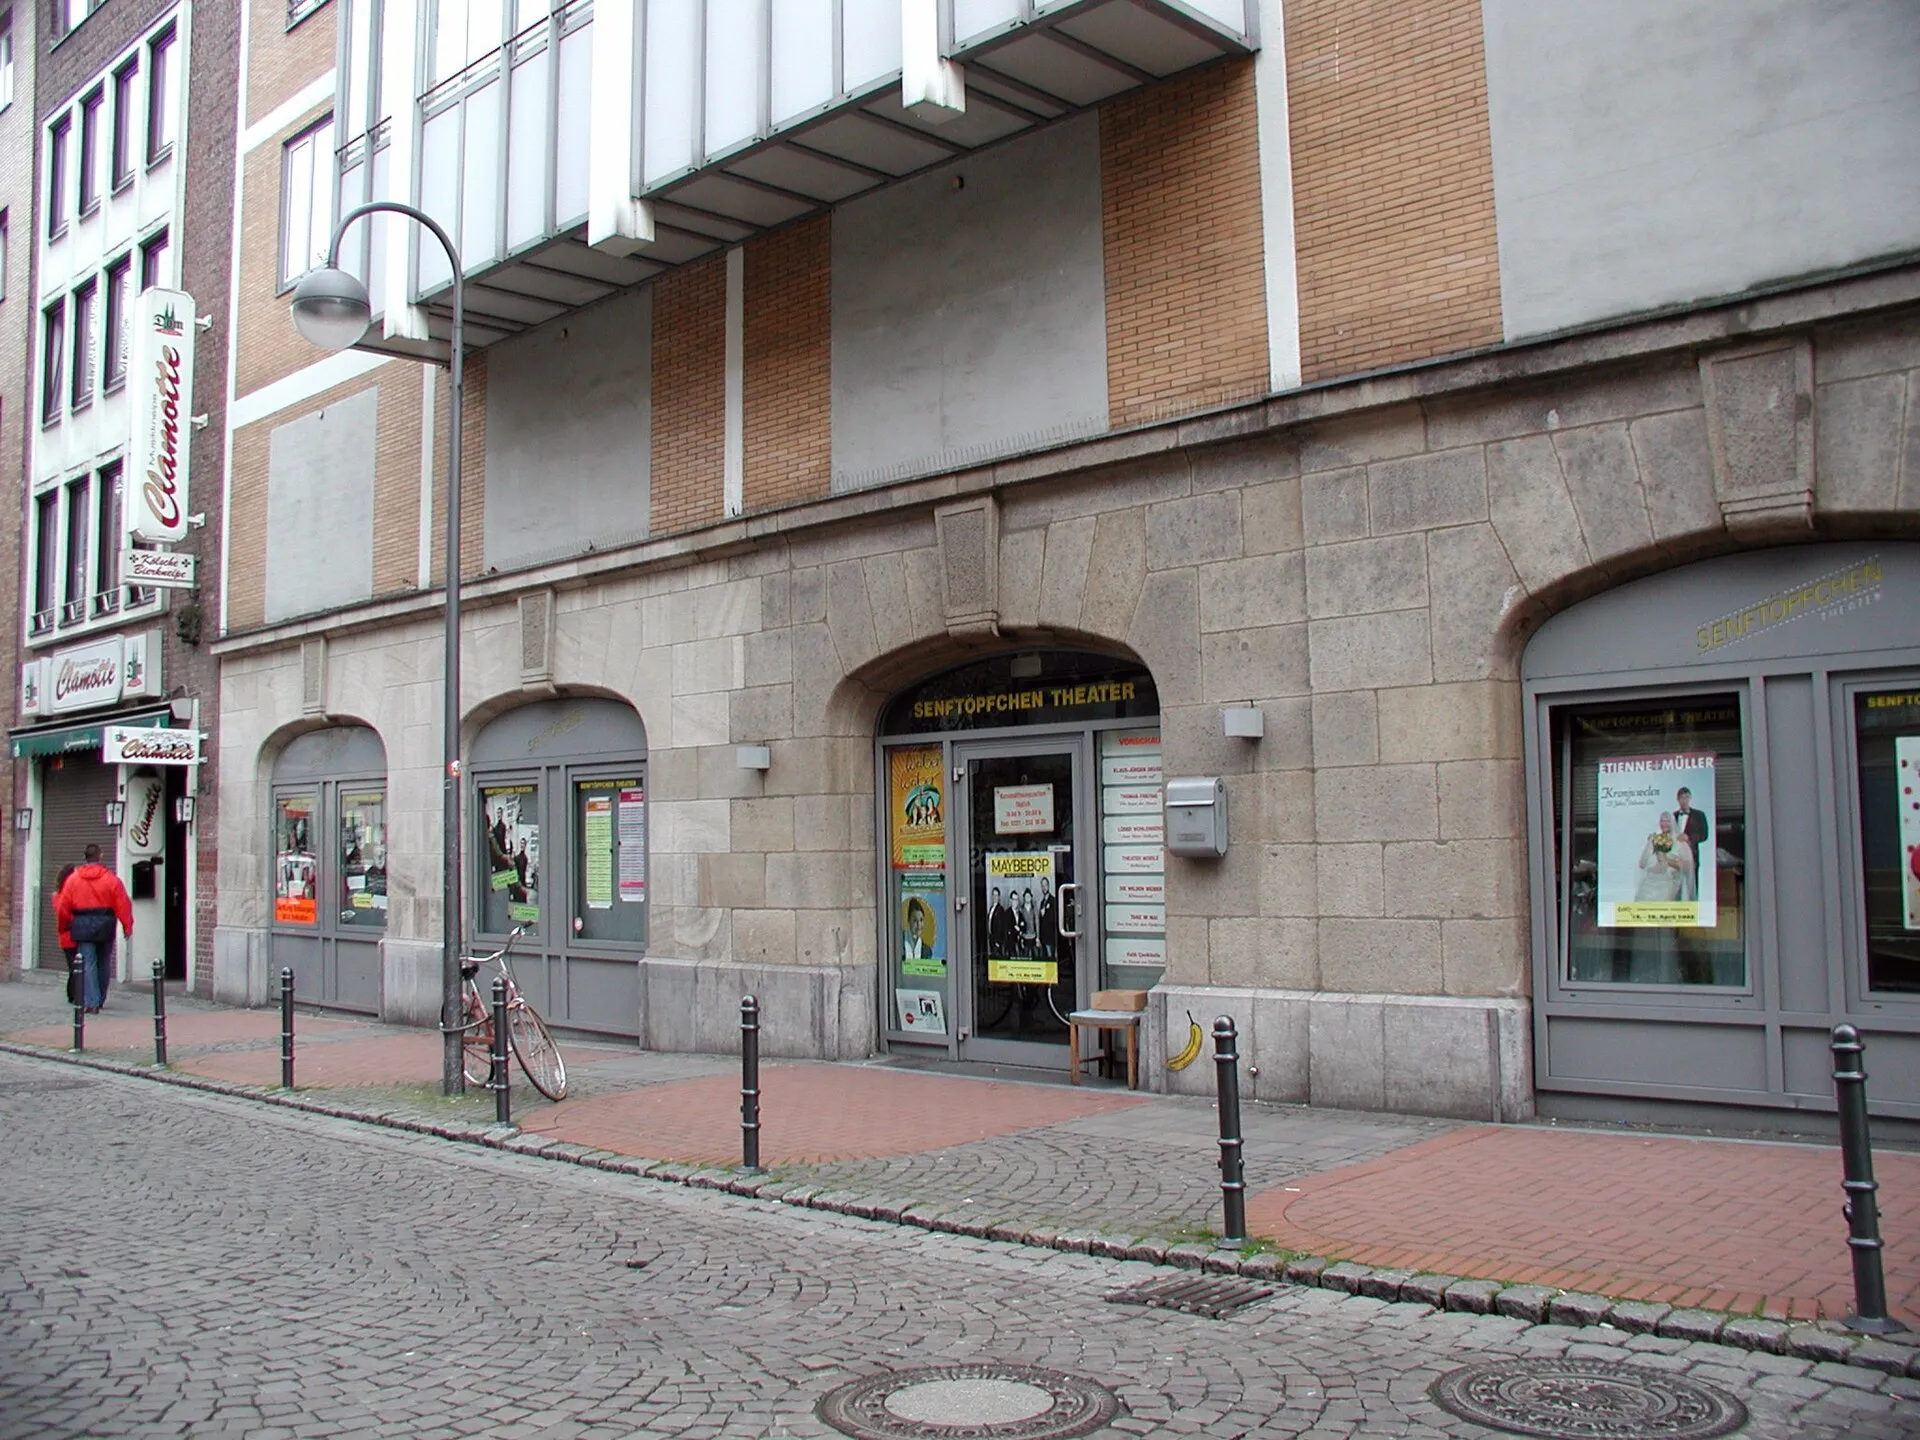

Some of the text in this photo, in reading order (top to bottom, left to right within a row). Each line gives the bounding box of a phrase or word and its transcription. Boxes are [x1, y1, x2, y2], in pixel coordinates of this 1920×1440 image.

[143, 344, 181, 528] Clamotte
[134, 563, 187, 579] Bierkneipe
[1696, 559, 1883, 650] SENFTÖPFCHEN
[56, 657, 117, 701] Clamotte
[914, 682, 1136, 718] SENFTÖPFCHEN THEATER
[130, 782, 162, 848] Clamotte
[991, 858, 1049, 873] MAYBEBOP
